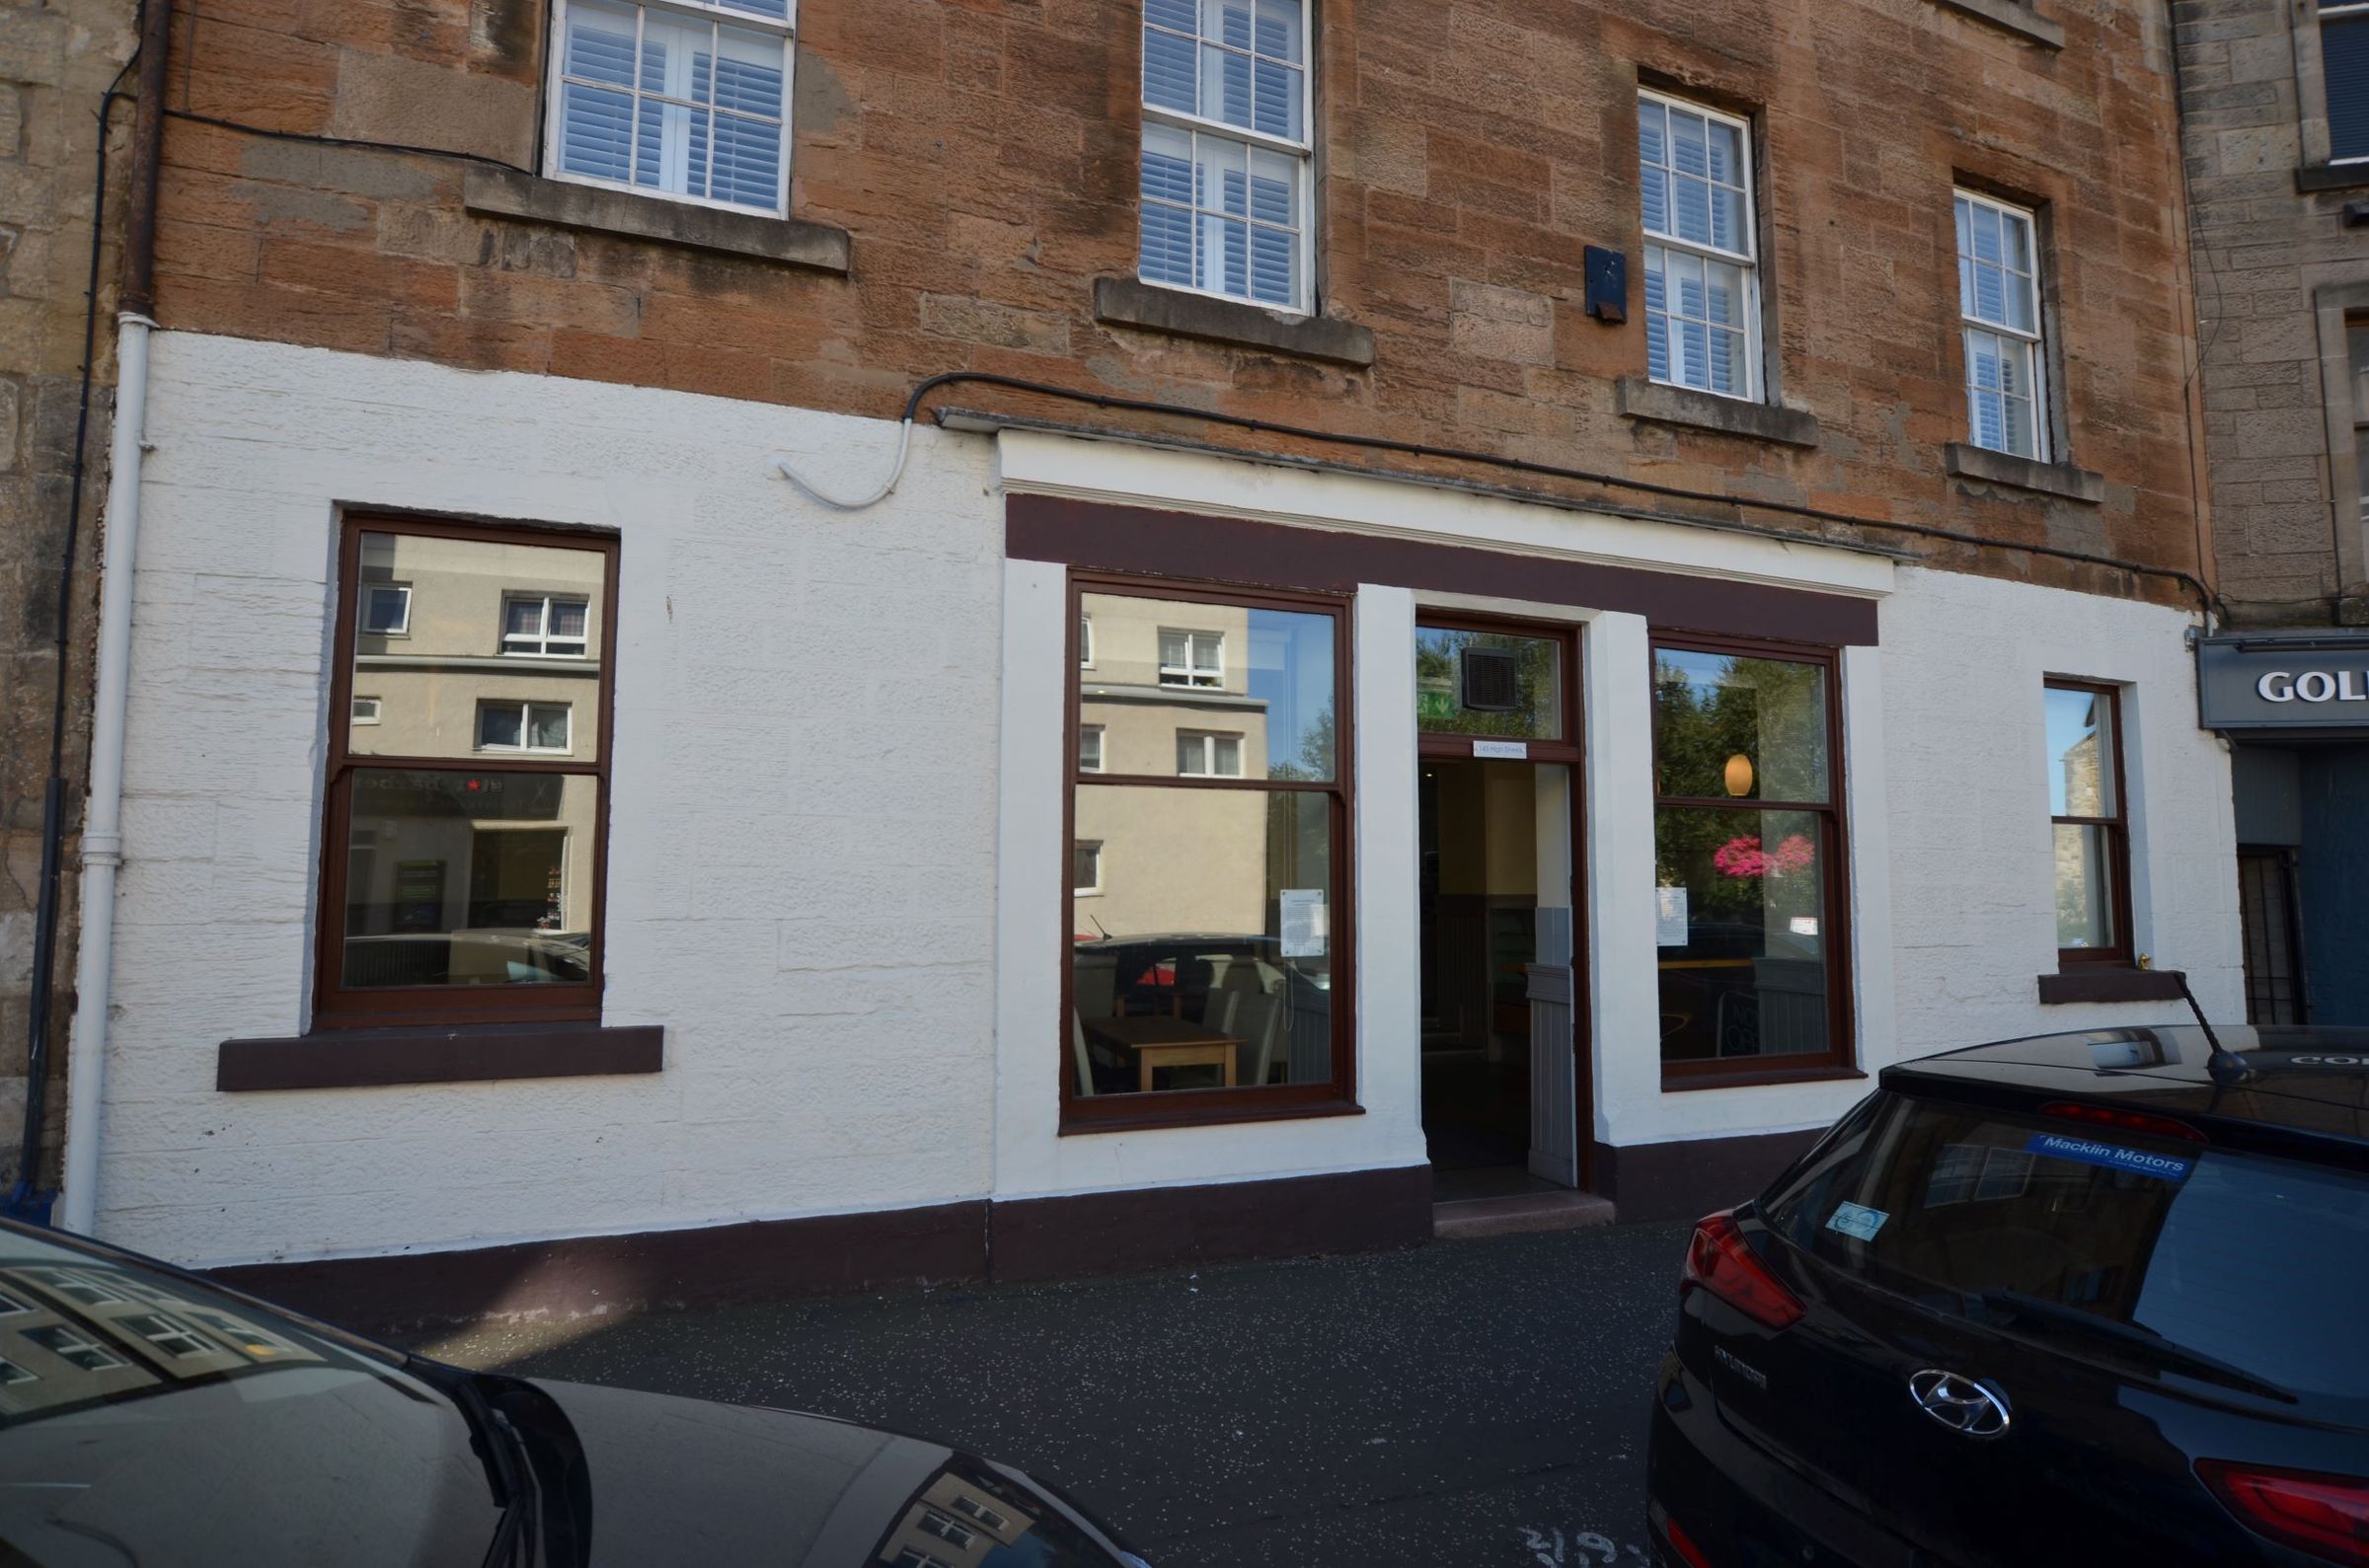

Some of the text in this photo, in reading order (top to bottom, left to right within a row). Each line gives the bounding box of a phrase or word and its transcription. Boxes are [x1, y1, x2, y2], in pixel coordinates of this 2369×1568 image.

[2257, 670, 2369, 703] GOL
[2044, 1136, 2111, 1157] Macklin
[2114, 1149, 2185, 1172] Motors
